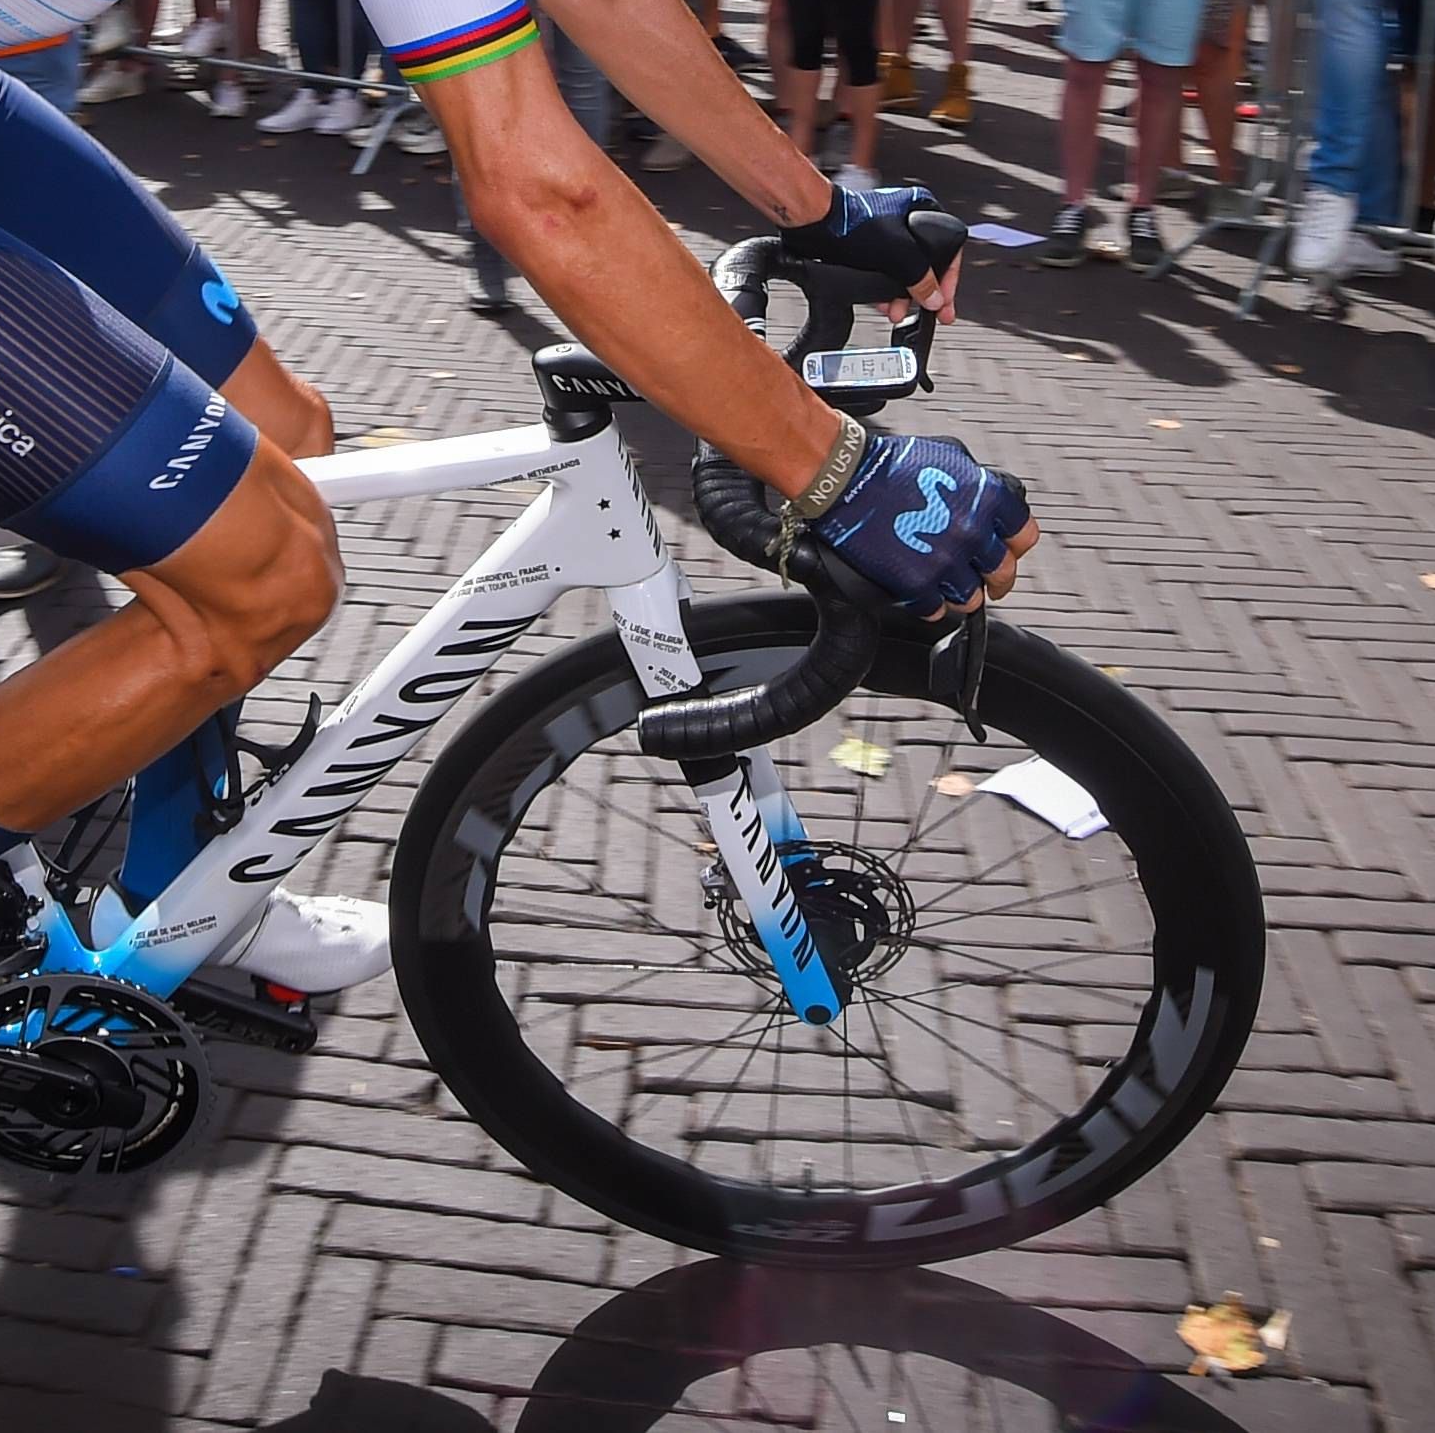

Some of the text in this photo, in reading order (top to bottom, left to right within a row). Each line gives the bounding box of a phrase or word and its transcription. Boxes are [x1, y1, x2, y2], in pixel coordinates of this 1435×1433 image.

[551, 374, 641, 398] CANY
[148, 391, 227, 490] CANYON
[808, 420, 861, 506] NOI US NO
[527, 458, 581, 480] NETHERLANDS
[518, 564, 548, 578] FRANCE
[521, 573, 550, 585] FRANCE
[228, 612, 543, 883] CANYON
[729, 765, 817, 974] CANYON
